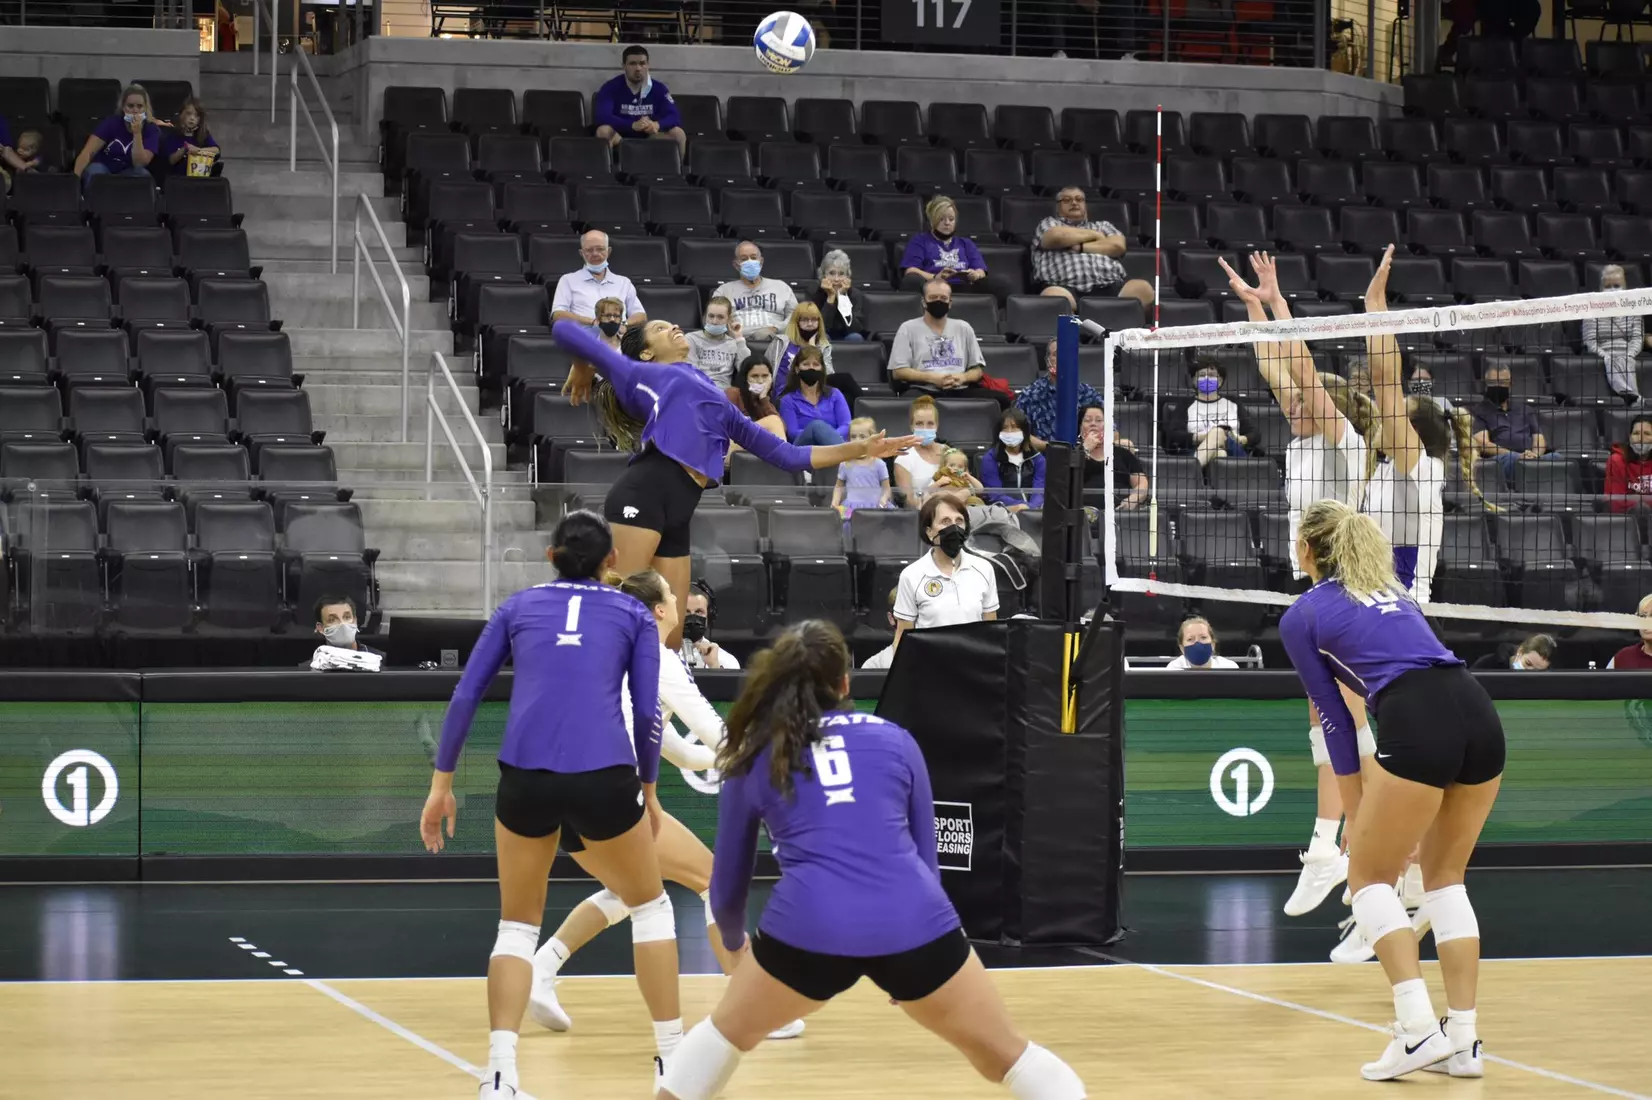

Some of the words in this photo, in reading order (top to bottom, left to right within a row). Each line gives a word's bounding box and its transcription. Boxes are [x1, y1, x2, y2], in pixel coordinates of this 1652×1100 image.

[912, 0, 972, 28] 117
[565, 595, 582, 631] 1
[811, 735, 852, 786] 6
[934, 816, 971, 832] SPORT
[937, 842, 970, 855] EASING
